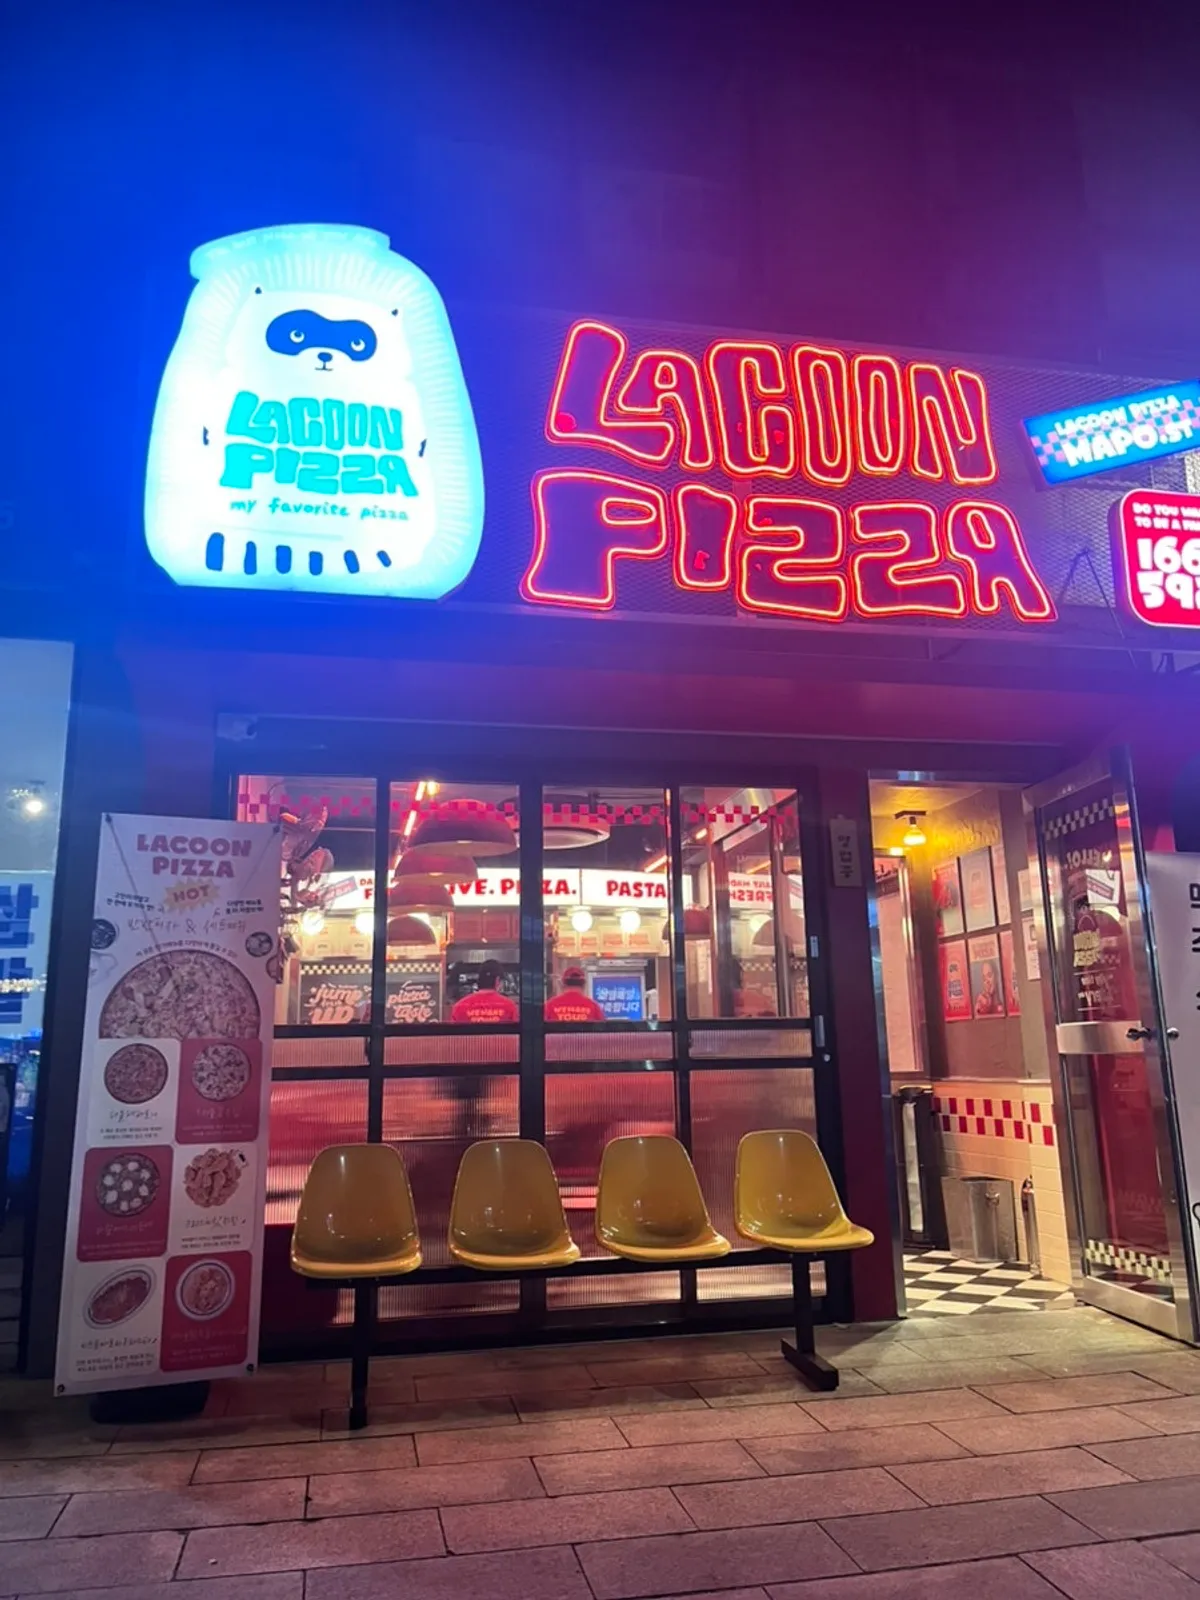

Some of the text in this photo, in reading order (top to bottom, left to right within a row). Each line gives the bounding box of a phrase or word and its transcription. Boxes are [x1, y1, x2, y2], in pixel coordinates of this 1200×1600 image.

[219, 443, 419, 497] PIZZA
[230, 498, 409, 521] my favorite pizza
[519, 467, 1059, 623] PIZZA
[137, 834, 252, 857] LACOON
[152, 856, 235, 878] PIZZA
[173, 885, 210, 902] HOT
[500, 879, 577, 895] PIZA.
[606, 880, 667, 898] PASTA
